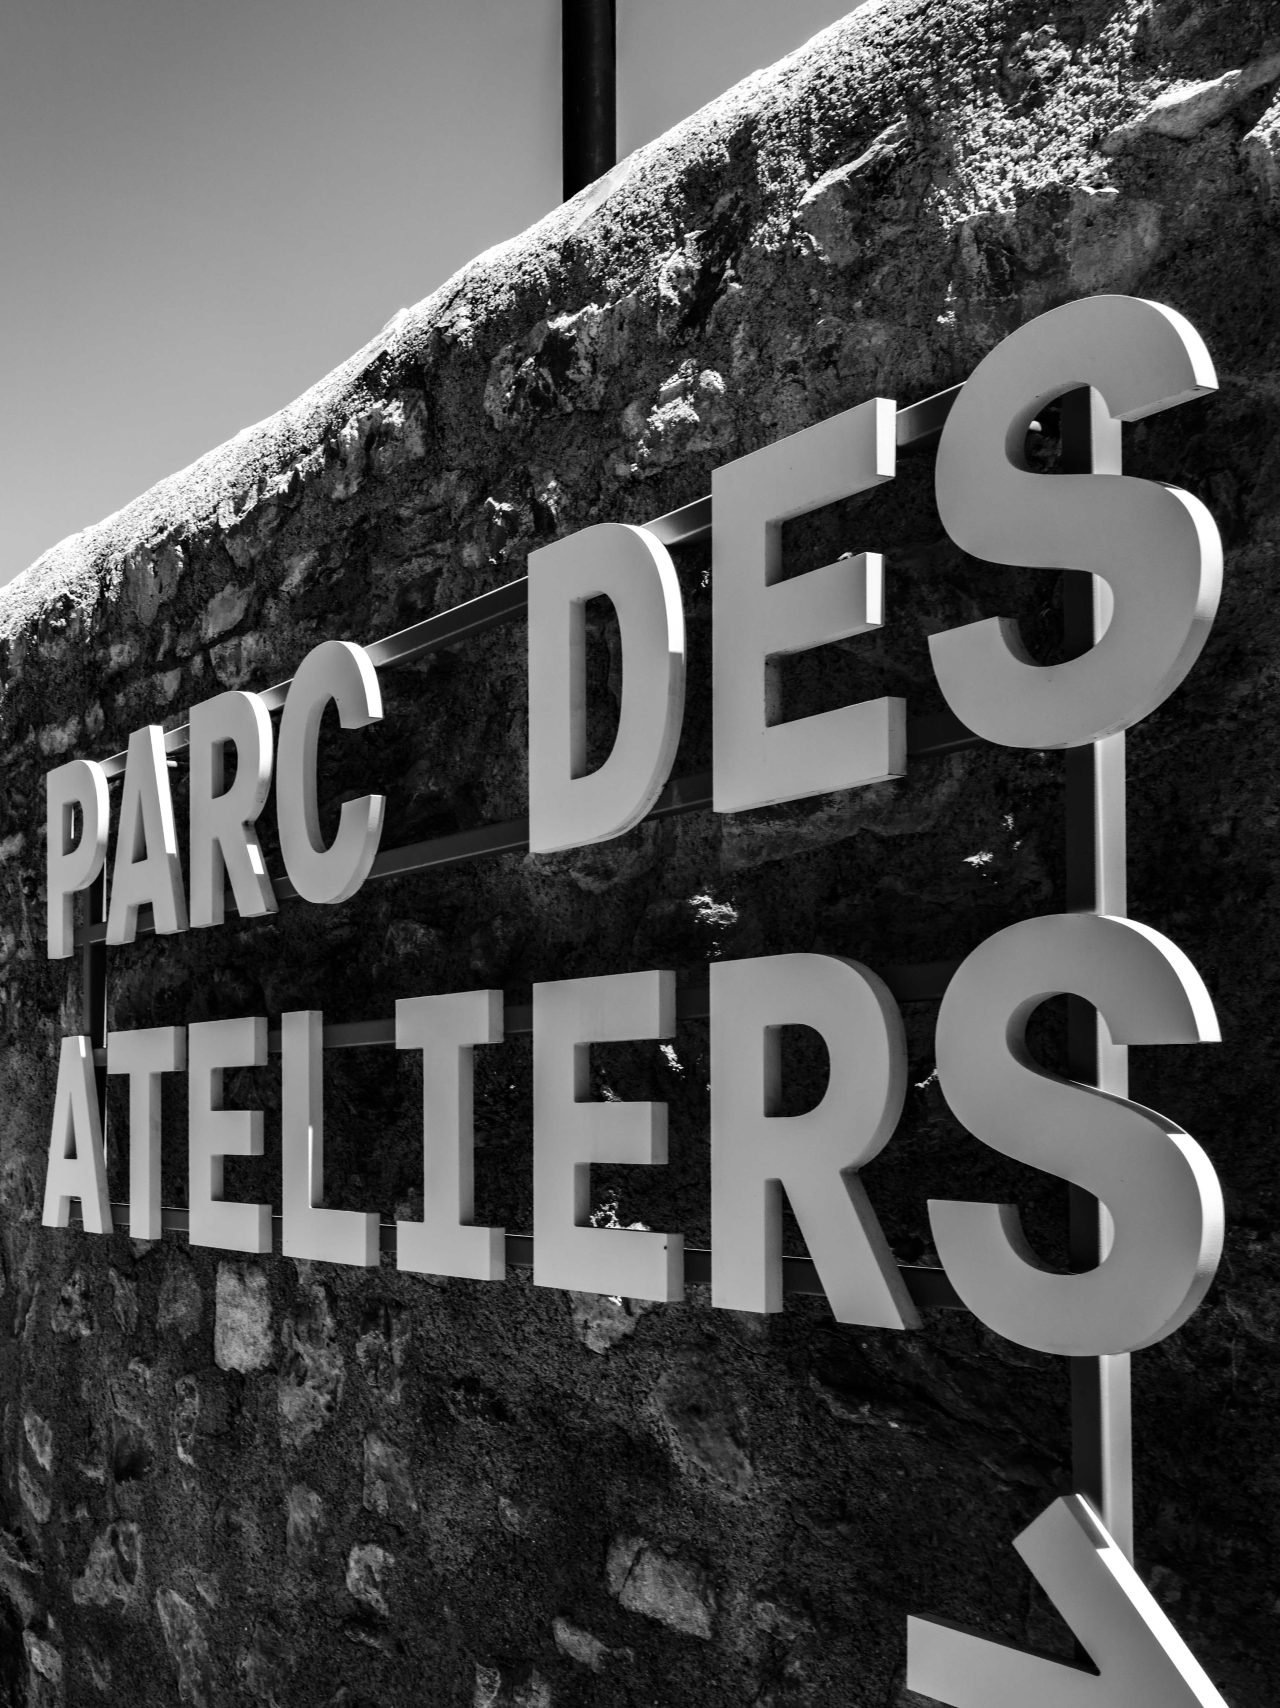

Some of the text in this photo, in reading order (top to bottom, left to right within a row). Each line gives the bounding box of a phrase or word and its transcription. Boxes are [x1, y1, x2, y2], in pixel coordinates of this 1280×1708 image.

[46, 294, 1224, 959] PARC DES
[41, 913, 1226, 1357] ATELIERS
